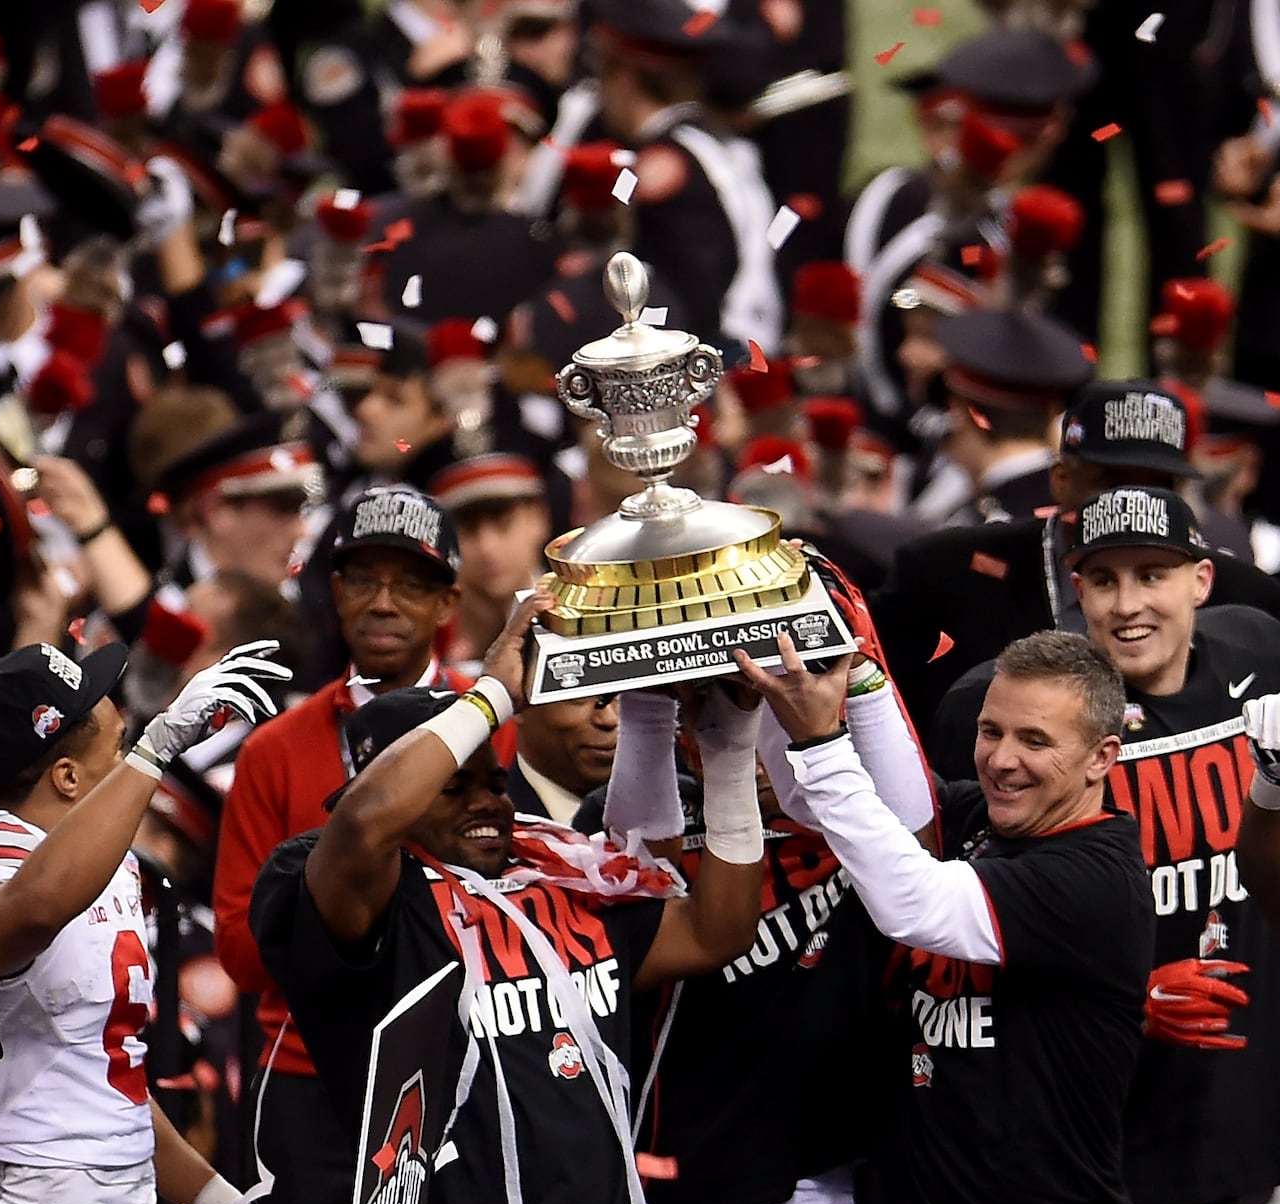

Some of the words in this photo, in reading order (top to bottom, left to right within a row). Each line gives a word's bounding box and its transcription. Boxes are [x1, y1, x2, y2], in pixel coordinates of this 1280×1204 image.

[1082, 497, 1122, 523] SUGAR
[1125, 497, 1169, 519] BOWL
[1082, 512, 1170, 545] CHAMPIONS
[588, 641, 655, 668] SUGAR
[657, 631, 710, 658] BOWL
[711, 620, 789, 647] CLASSIC
[655, 651, 729, 674] CHAMPION
[1151, 858, 1205, 916] OT
[470, 977, 543, 1039] NOT
